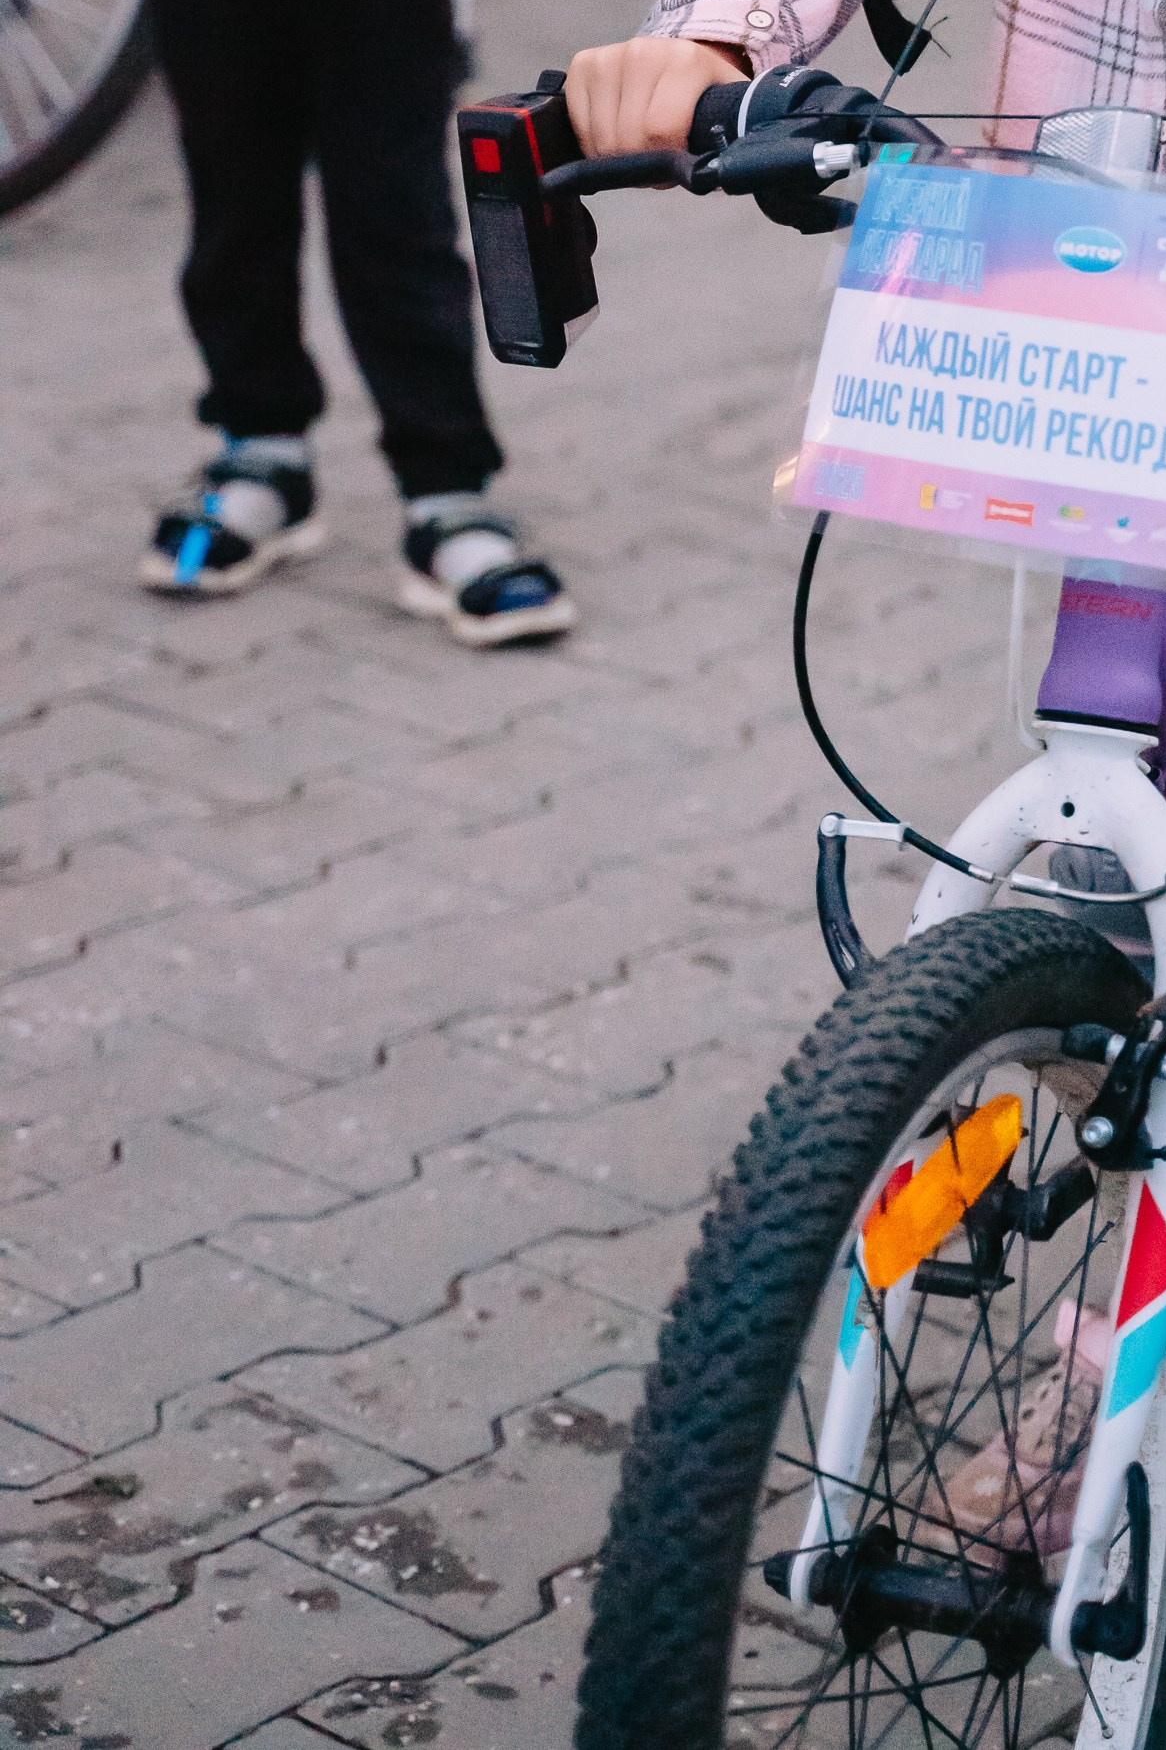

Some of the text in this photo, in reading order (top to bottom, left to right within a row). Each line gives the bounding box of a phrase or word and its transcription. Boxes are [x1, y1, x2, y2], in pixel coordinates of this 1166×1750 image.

[1059, 242, 1123, 262] МОТОР
[875, 320, 1012, 384] КАЖДЫЙ
[1018, 342, 1127, 399] СТАРТ
[831, 374, 903, 427] ШАНС
[907, 385, 945, 434] НА
[956, 393, 1037, 450] ТВОЙ
